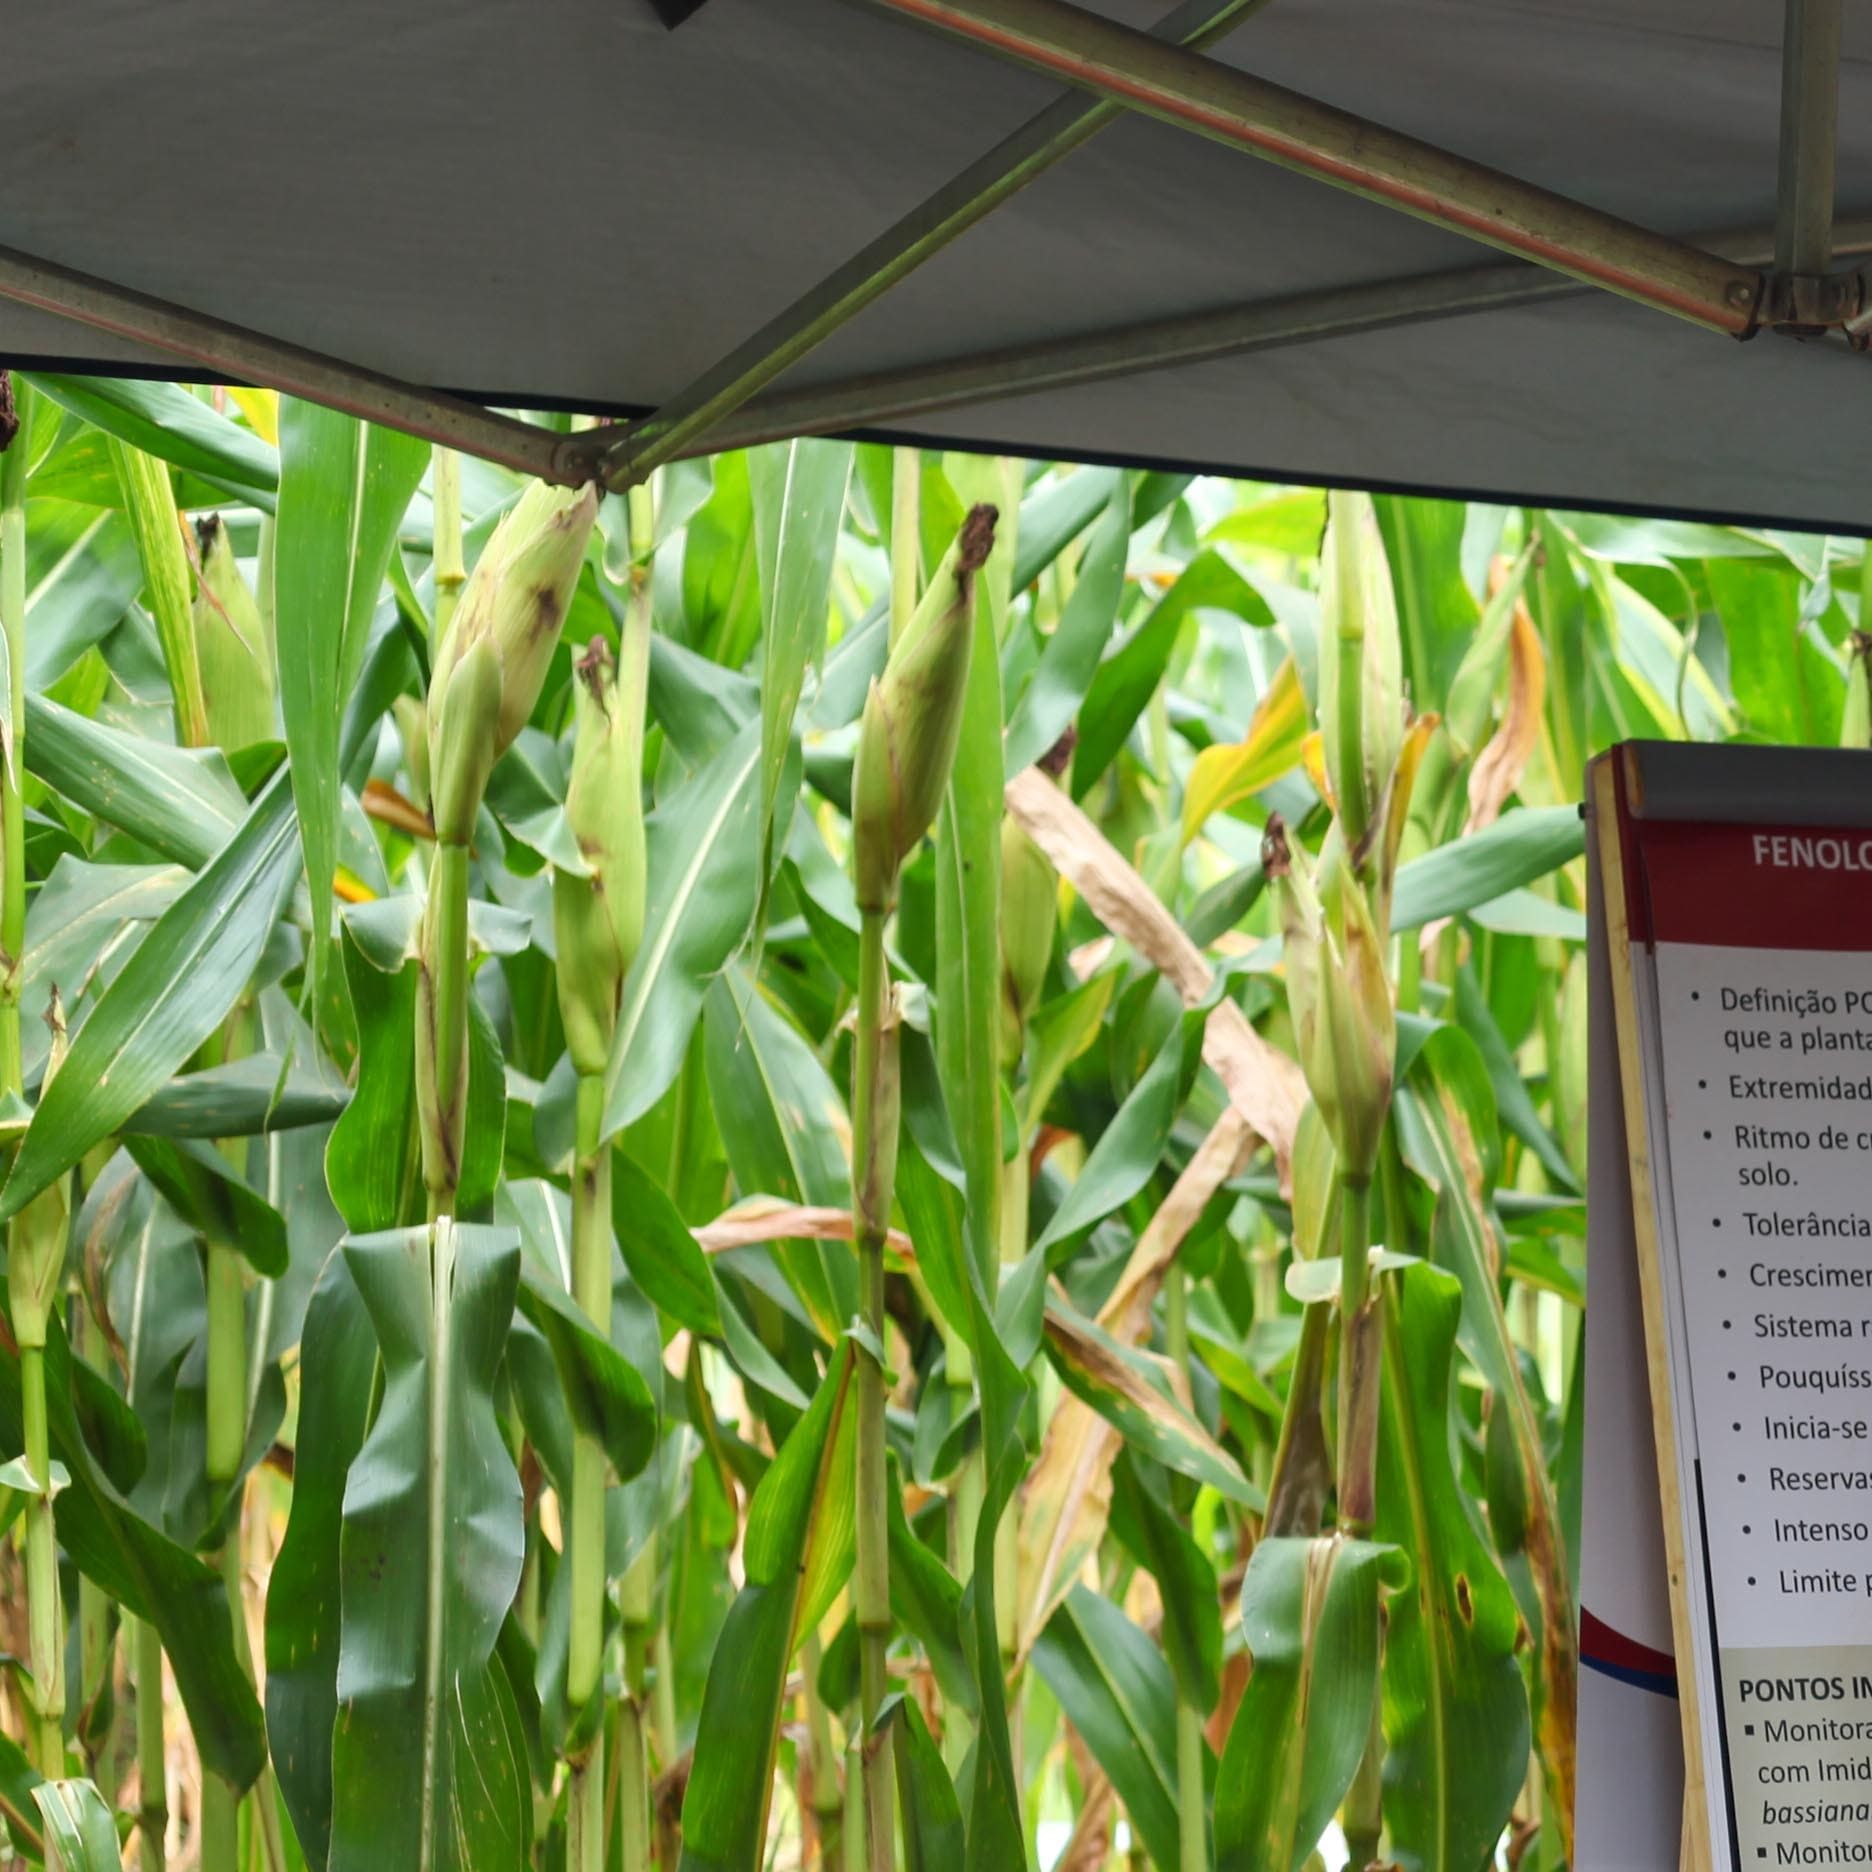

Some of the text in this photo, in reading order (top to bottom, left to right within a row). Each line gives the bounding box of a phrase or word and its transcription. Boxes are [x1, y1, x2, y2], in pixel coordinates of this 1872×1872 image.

[1721, 988, 1836, 1018] Definição
[1743, 1212, 1871, 1237] Tolerância
[1755, 1314, 1852, 1337] Sistema
[1765, 1416, 1867, 1439] Inicia-se
[1775, 1519, 1868, 1542] Intenso
[1740, 1677, 1844, 1702] PONTOS
[1759, 1765, 1809, 1783] com
